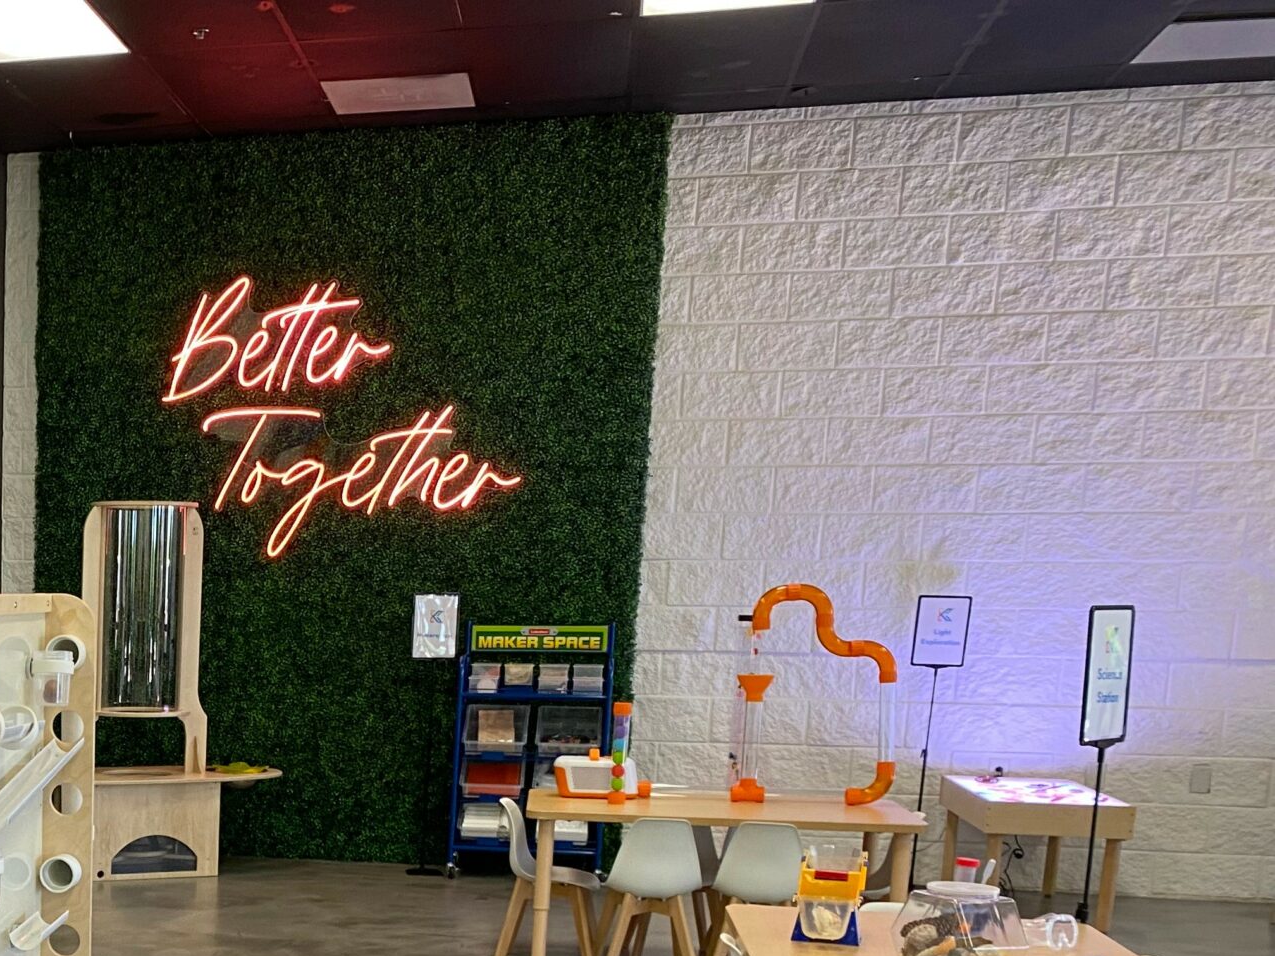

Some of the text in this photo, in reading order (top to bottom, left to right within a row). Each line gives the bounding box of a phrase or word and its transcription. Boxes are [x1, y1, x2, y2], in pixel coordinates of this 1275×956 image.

[162, 276, 391, 403] Better
[202, 404, 522, 558] Together
[478, 635, 601, 649] MAKER SPACE
